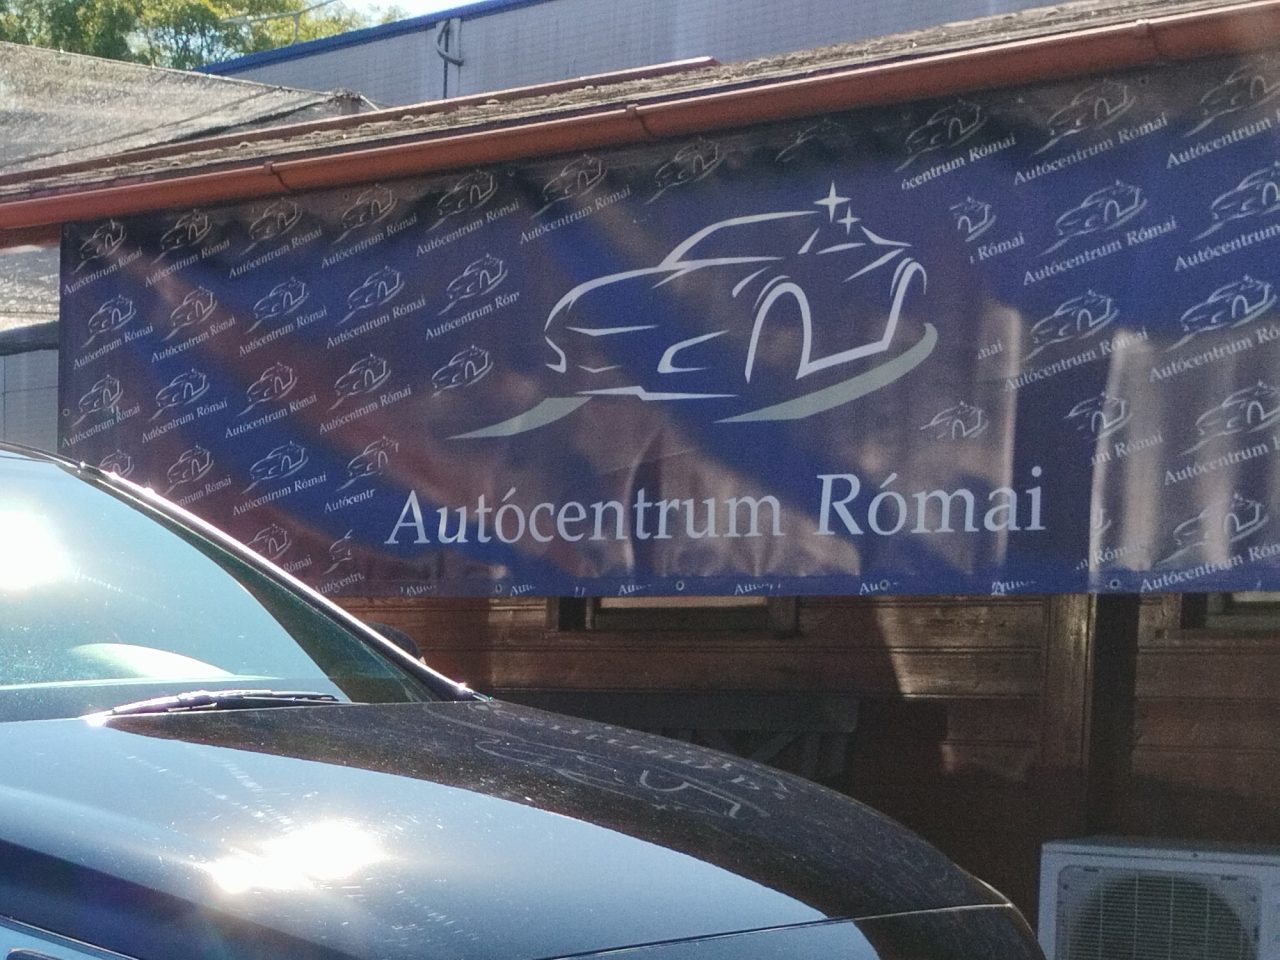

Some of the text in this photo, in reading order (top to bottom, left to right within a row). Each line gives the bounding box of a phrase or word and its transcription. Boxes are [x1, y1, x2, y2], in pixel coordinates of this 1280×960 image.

[969, 132, 1016, 162] Római
[1013, 112, 1168, 186] Autócentrum Római
[1166, 117, 1272, 169] Autócentrum
[416, 198, 519, 257] Autócentrum Római
[519, 187, 631, 245] Autócentrum Római
[145, 239, 230, 288] Autócentrum Római
[229, 228, 322, 279] Autócentrum Római
[320, 215, 417, 269] Autócentrum Római
[977, 232, 1025, 261] Római
[1023, 215, 1177, 286] Autócentrum Római
[1174, 223, 1280, 272] Autócentrum
[64, 249, 143, 295] Autócentrum Római
[151, 317, 235, 364] Autócentrum Római
[239, 307, 327, 357] Autócentrum Római
[326, 298, 426, 349] Autócentrum Római
[425, 302, 493, 341] Autócentrum
[73, 323, 153, 370] Autócentrum Római
[1005, 327, 1149, 391] Autócentrum Római
[1150, 336, 1253, 382] Autócentrum
[62, 418, 114, 449] Autócentrum
[141, 399, 228, 444] Autócentrum Római
[225, 393, 318, 439] Autócentrum Római
[319, 385, 412, 435] Autócentrum Római
[1114, 431, 1164, 457] Római
[1164, 444, 1269, 485] Autócentrum
[205, 474, 232, 493] Római
[233, 487, 291, 516] Autócentrum
[294, 473, 327, 491] Római
[385, 465, 1045, 545] Autócentrum Római
[1140, 555, 1243, 592] Autócentrum
